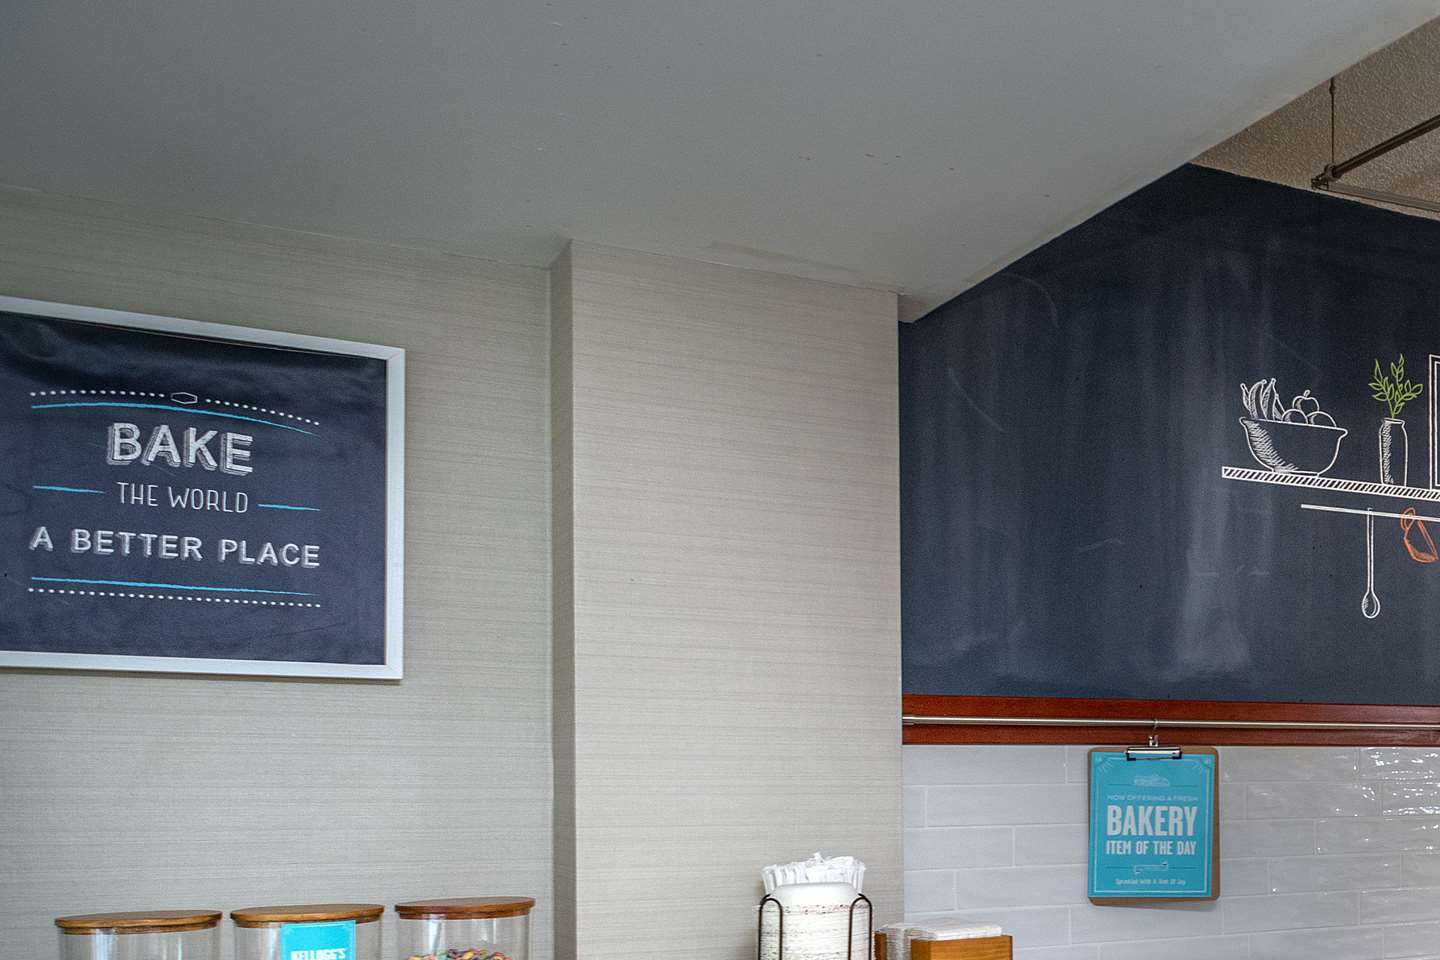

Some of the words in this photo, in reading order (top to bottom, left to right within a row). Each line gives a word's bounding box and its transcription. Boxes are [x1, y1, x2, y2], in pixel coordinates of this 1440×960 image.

[107, 422, 253, 476] BAKE
[117, 481, 159, 507] THE
[168, 486, 249, 513] WORLD
[29, 526, 53, 552] A
[71, 528, 203, 561] BETTER
[217, 538, 320, 568] PLACE
[1106, 805, 1198, 836] BAKERY
[1106, 840, 1131, 855] ITEM
[1136, 840, 1149, 855] OF
[1153, 841, 1173, 855] THE
[1177, 841, 1197, 855] DAY
